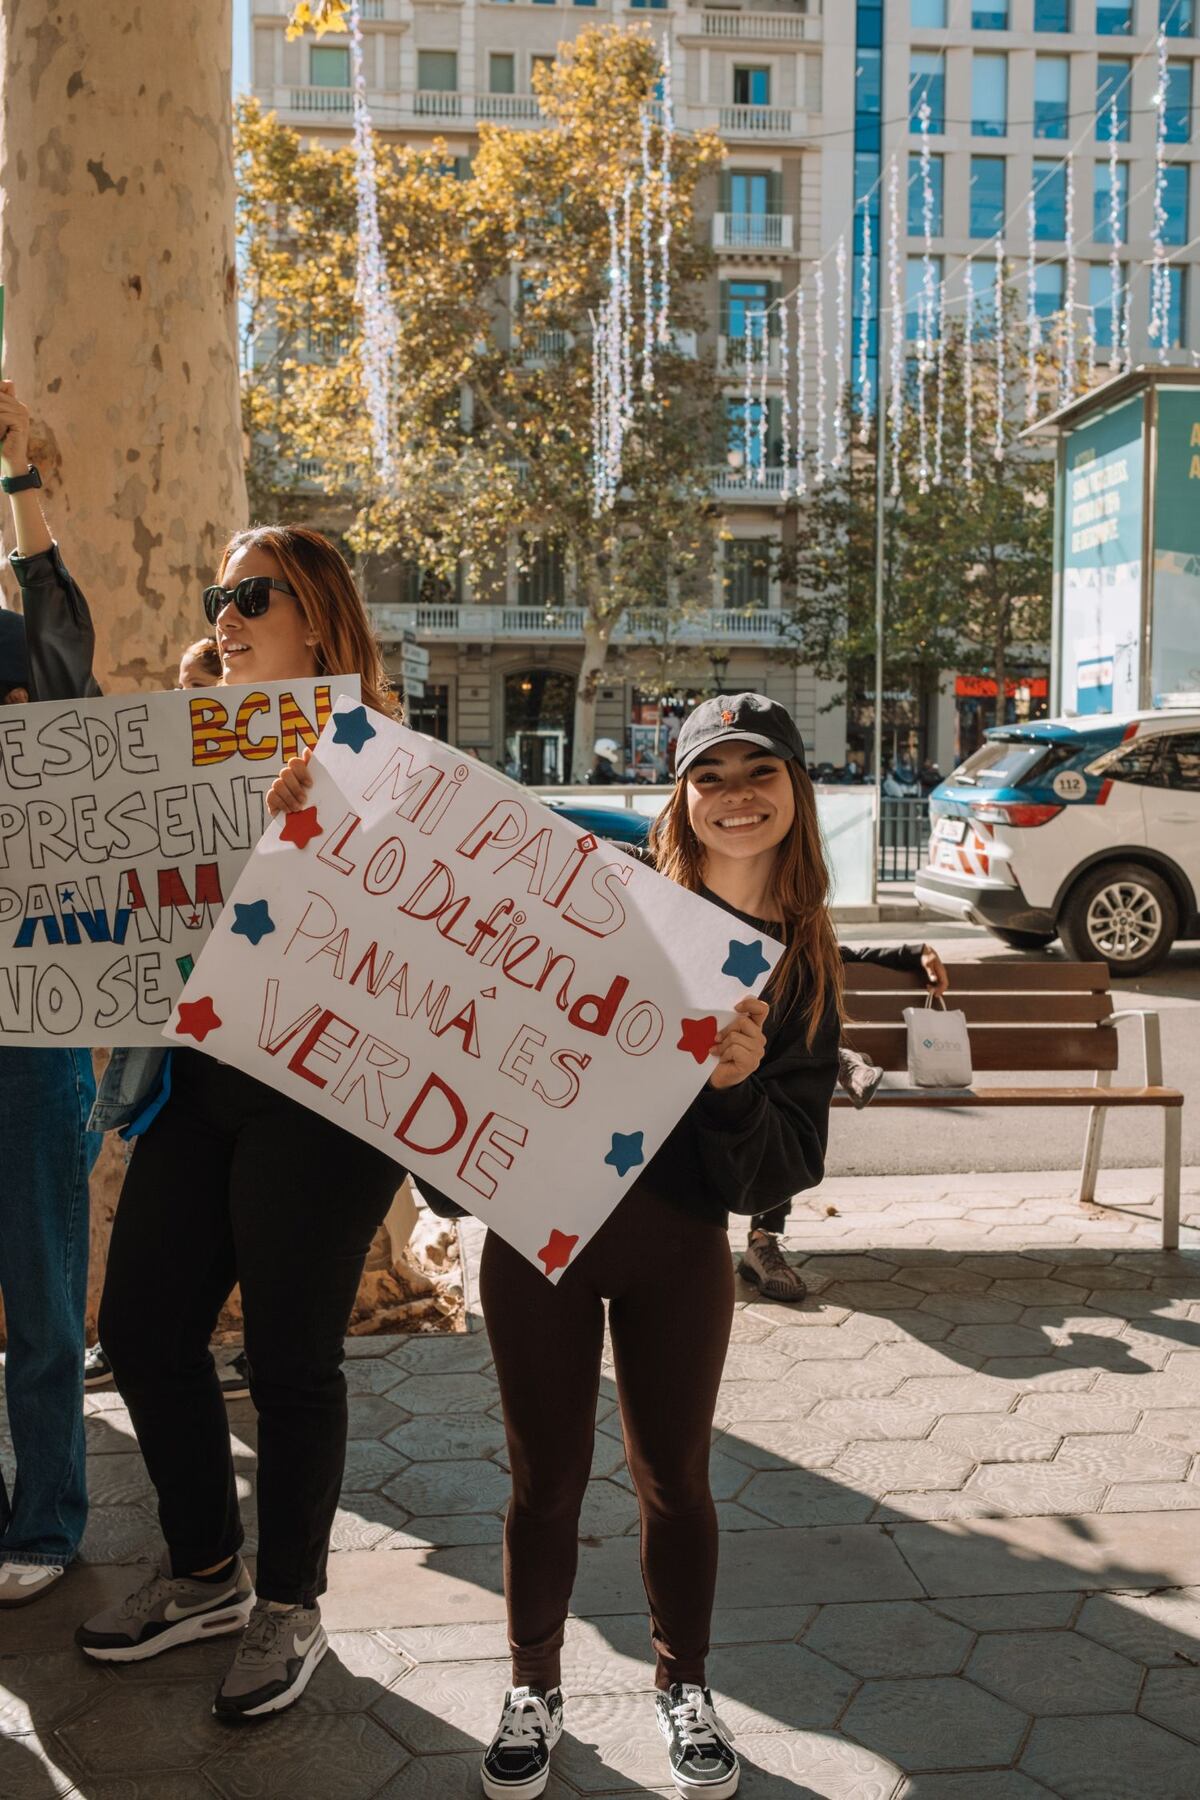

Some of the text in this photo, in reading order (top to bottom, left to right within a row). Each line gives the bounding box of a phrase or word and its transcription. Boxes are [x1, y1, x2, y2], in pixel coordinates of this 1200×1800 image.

[0, 685, 332, 789] ESDE BCN
[1060, 779, 1080, 789] 112
[317, 812, 406, 895] LO
[0, 963, 83, 1035] NO
[95, 952, 172, 1028] SE
[258, 978, 529, 1200] VERDE
[498, 1024, 592, 1109] ES
